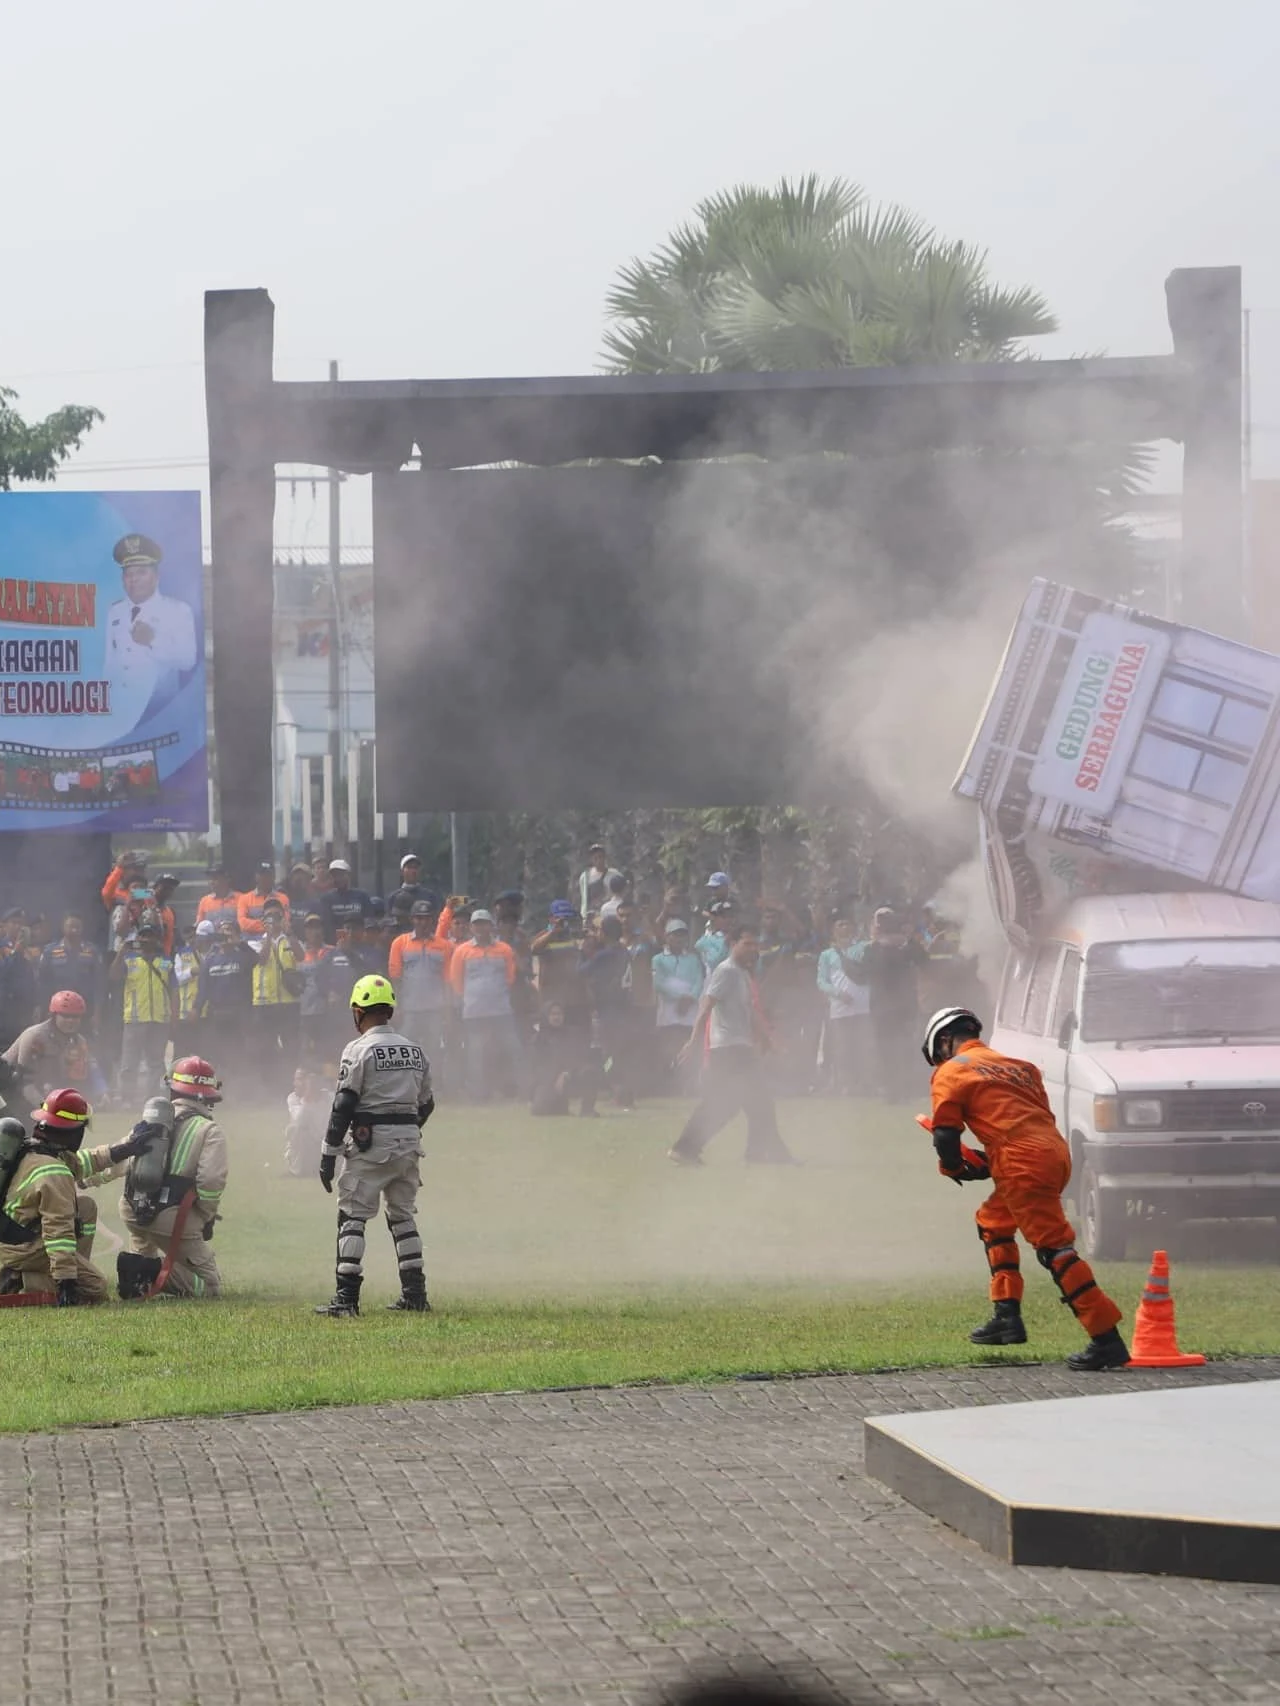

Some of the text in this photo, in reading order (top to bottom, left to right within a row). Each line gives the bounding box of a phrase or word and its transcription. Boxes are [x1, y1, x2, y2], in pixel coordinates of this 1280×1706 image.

[1055, 656, 1110, 761] GEDUNG
[1074, 644, 1148, 793] SERBAGUNA
[375, 1047, 421, 1060] BPBD
[378, 1059, 422, 1069] JOMBANG
